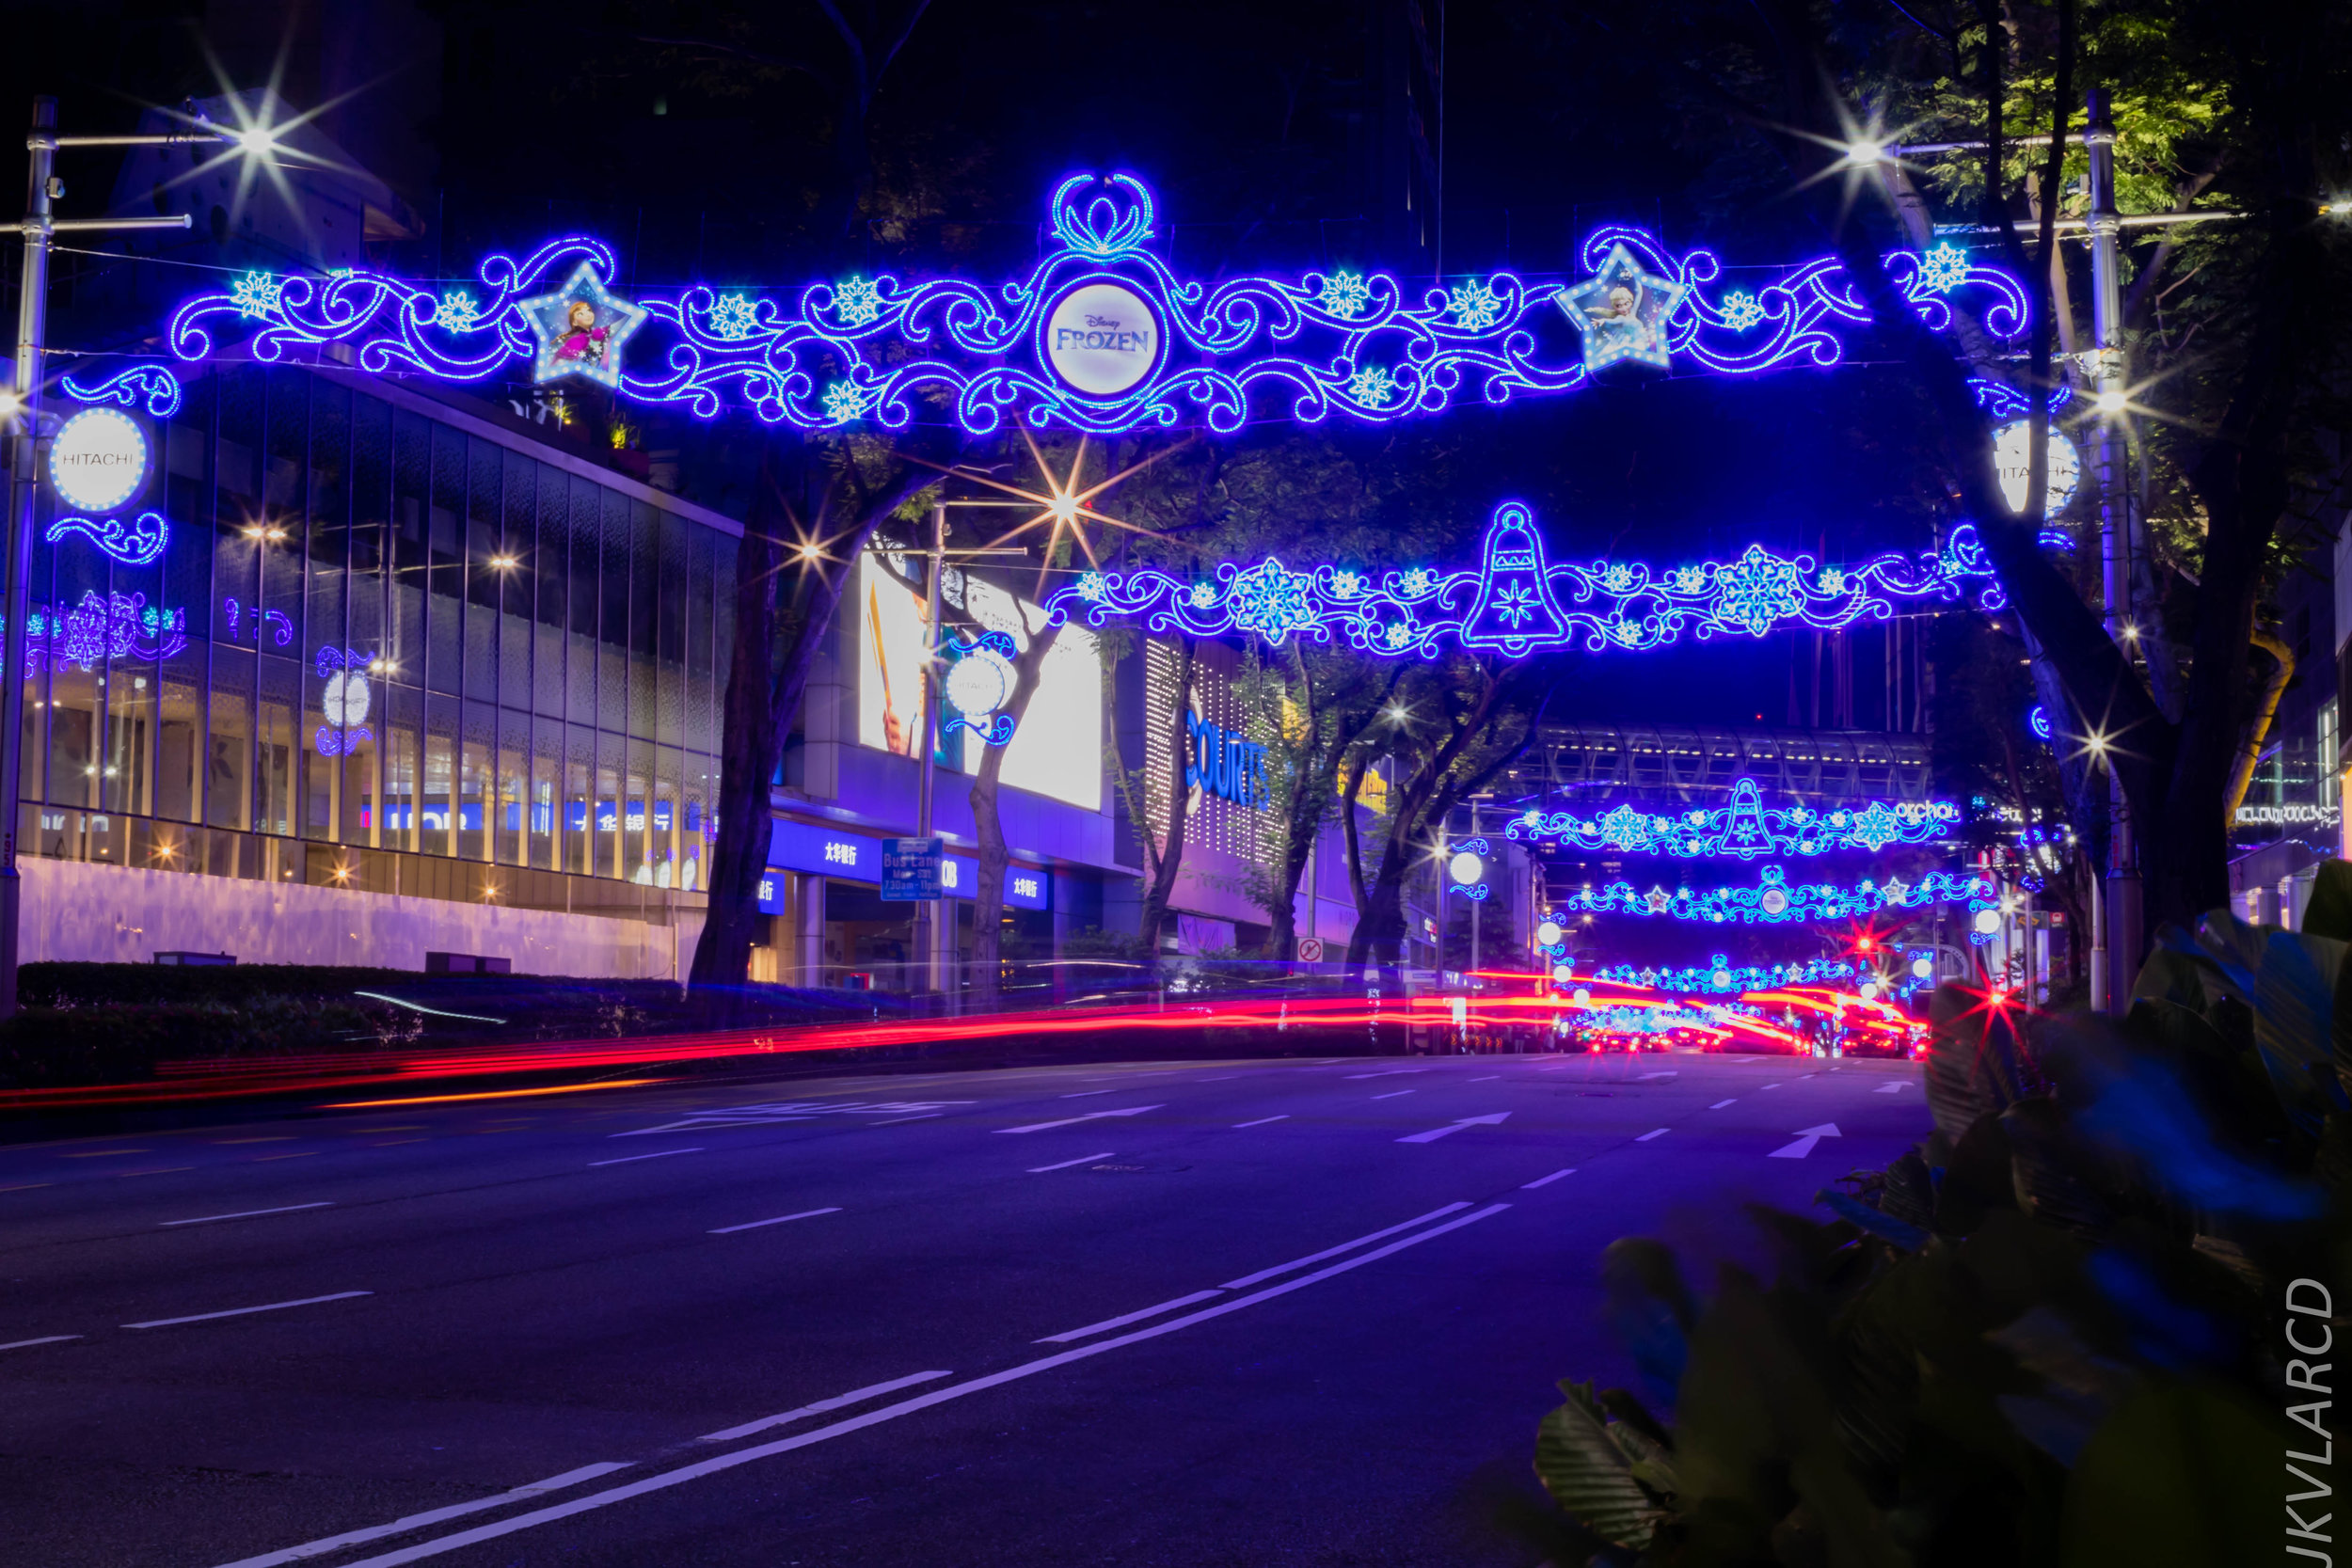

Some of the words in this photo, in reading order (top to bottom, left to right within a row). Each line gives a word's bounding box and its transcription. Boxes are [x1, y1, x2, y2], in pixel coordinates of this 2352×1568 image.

[1085, 314, 1120, 330] Disney
[1056, 327, 1149, 353] FROZEN
[62, 453, 133, 466] HITACHI
[883, 853, 907, 867] Bus
[911, 854, 941, 867] Lane
